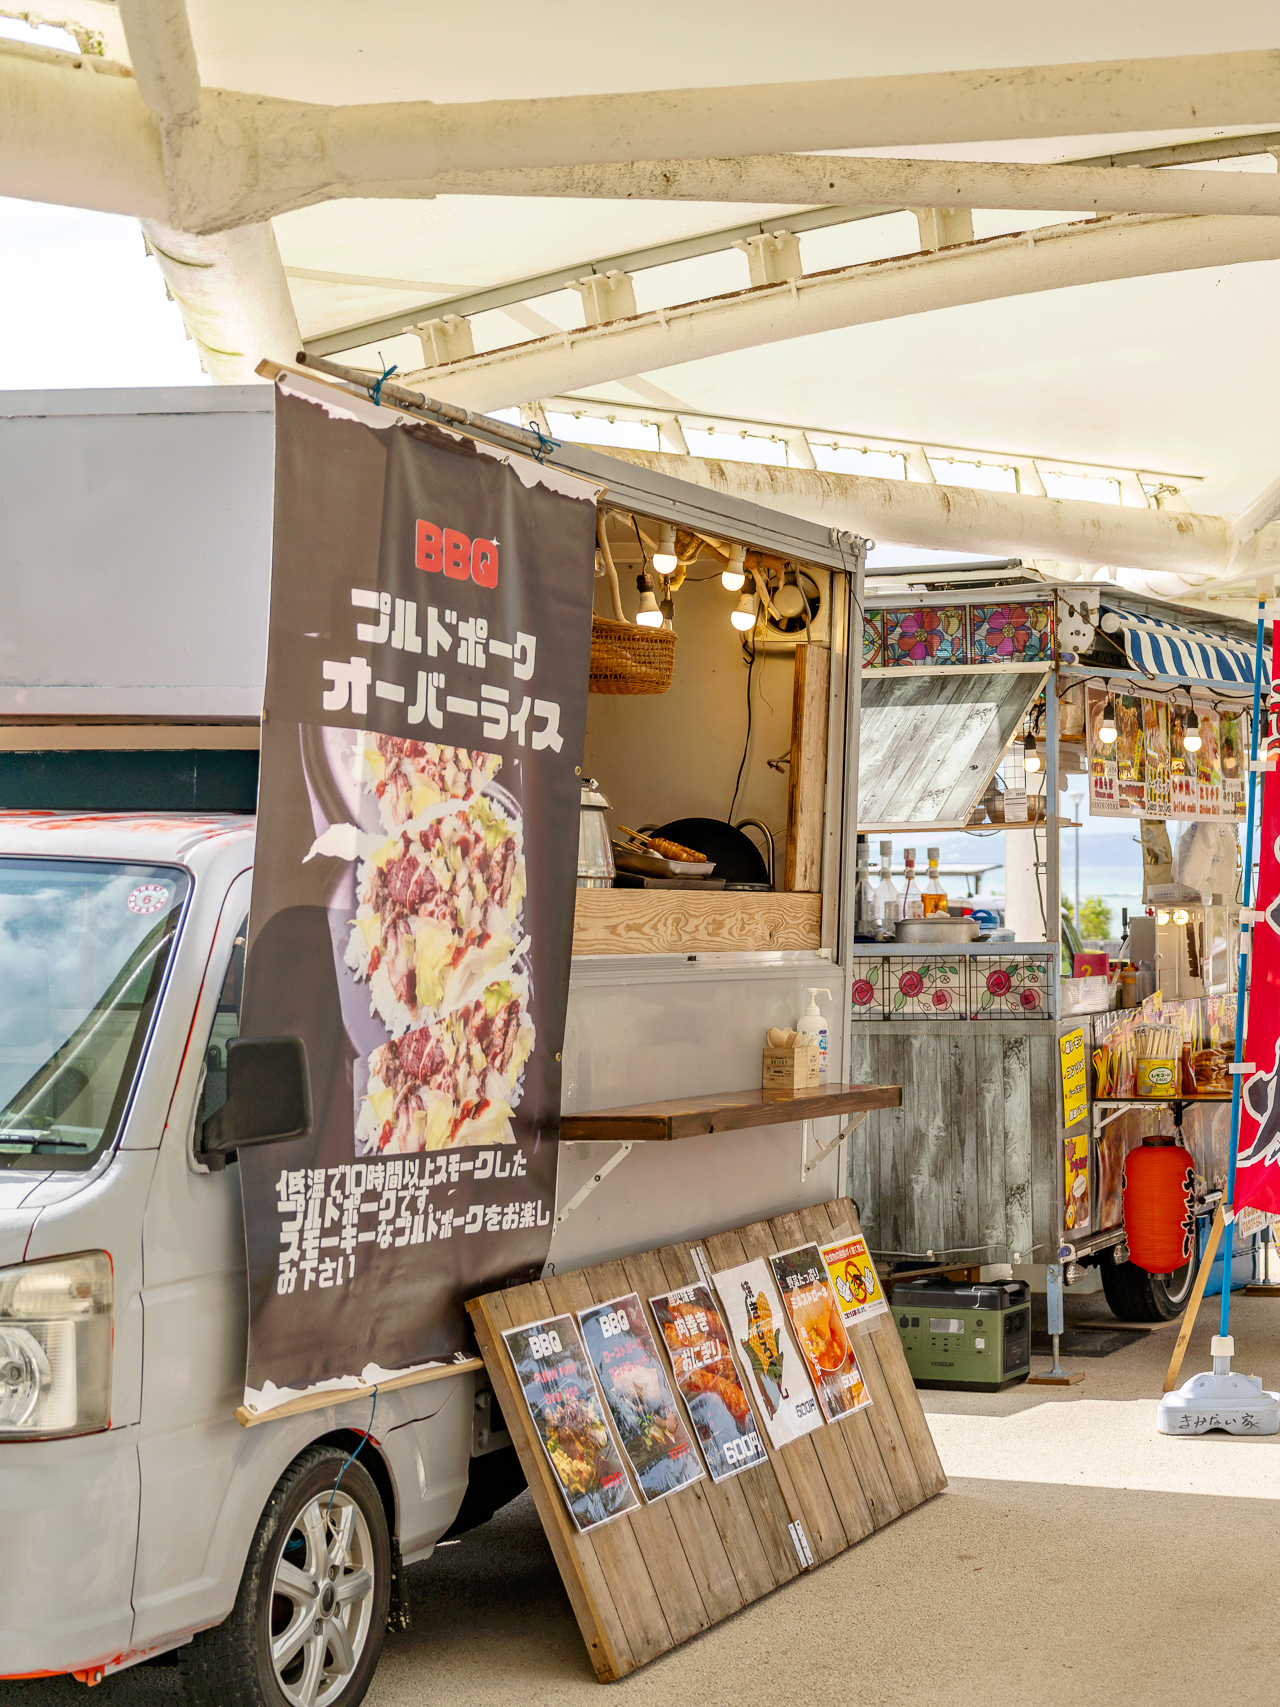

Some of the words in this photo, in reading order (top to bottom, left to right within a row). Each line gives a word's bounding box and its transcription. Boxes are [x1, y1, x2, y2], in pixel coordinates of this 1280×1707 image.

[415, 518, 500, 589] BBQ
[350, 587, 537, 681] プルドポーク
[322, 656, 565, 754] オーバーライス
[143, 895, 152, 904] 6
[1066, 1059, 1084, 1079] コンソメ
[275, 1150, 527, 1201] 低温で10時間以上スモークした
[277, 1186, 434, 1232] プルドポークです。
[279, 1200, 550, 1263] スモーキーなプルドポークをお楽し
[277, 1255, 356, 1295] み下さい
[785, 1267, 820, 1289] 野菜たっぷり
[790, 1285, 828, 1309] ミネストローネ
[599, 1309, 630, 1338] BBQ
[674, 1311, 710, 1339] 肉巻き
[528, 1330, 563, 1359] BBQ
[681, 1338, 722, 1372] おにぎり
[533, 1366, 559, 1386] Pulled
[559, 1361, 577, 1378] pork
[563, 1385, 580, 1399] rice
[1178, 1412, 1260, 1430] まかない家
[723, 1431, 763, 1465] 600円
